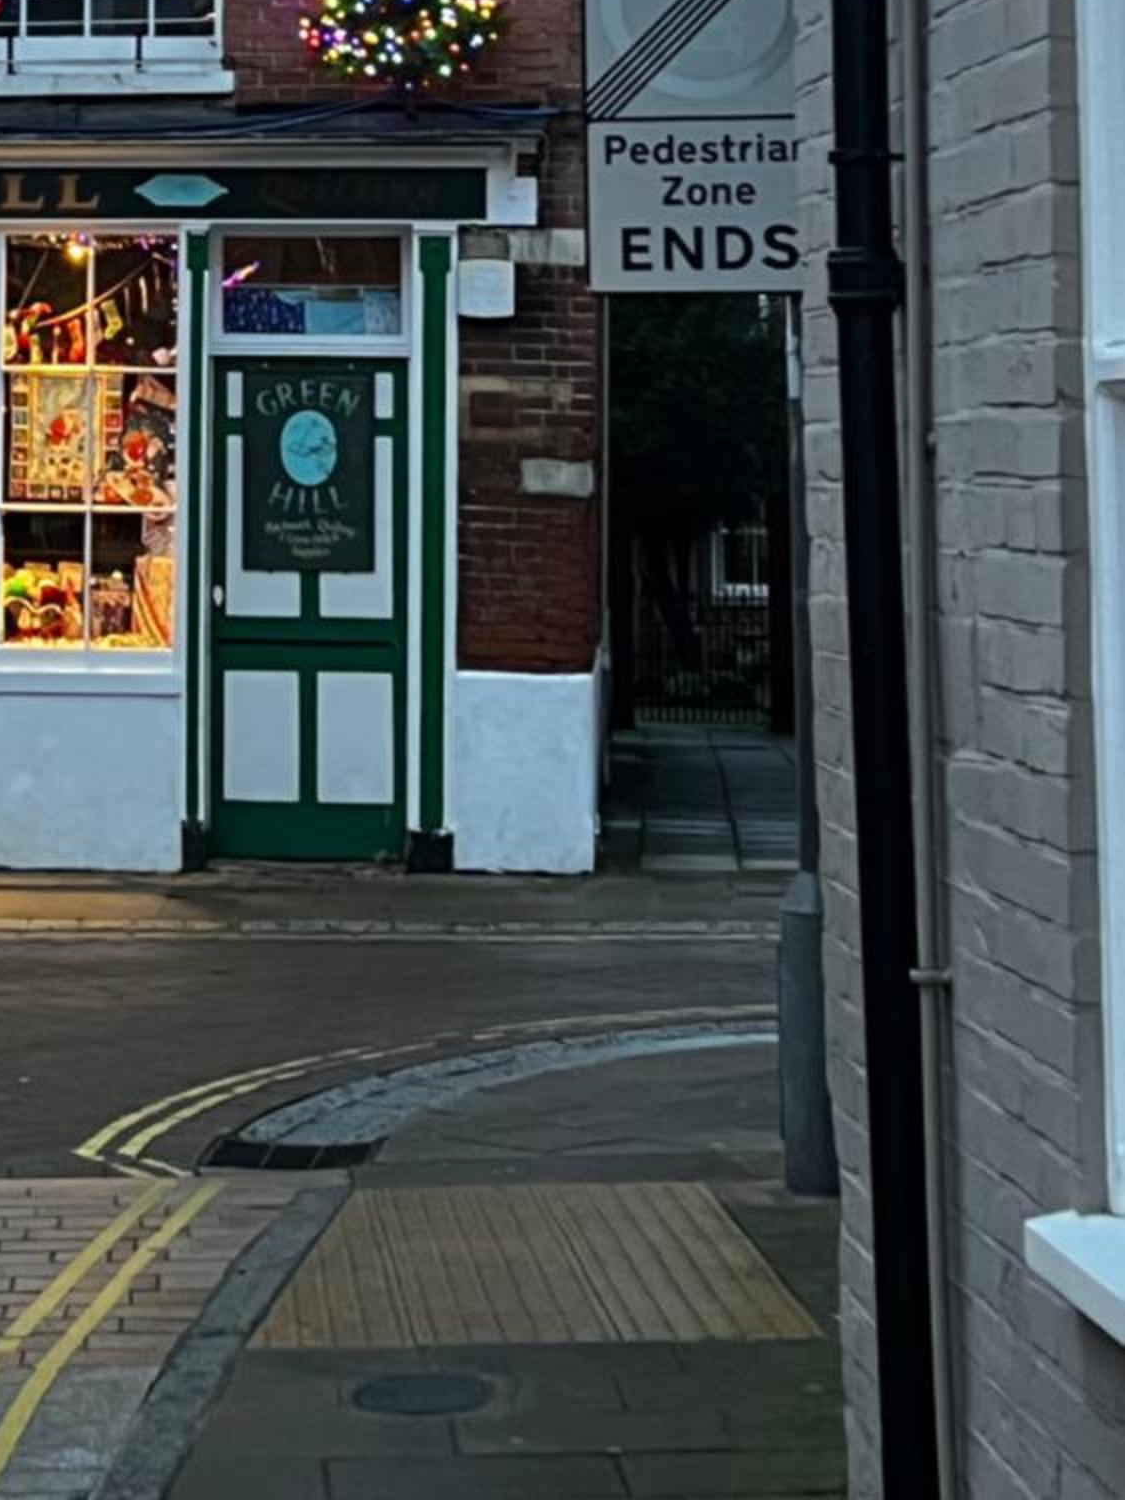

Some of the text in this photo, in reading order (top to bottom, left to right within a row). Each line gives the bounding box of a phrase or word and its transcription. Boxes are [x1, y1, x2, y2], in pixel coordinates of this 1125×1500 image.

[661, 177, 757, 206] Zone
[621, 225, 800, 271] ENDS
[256, 380, 360, 418] GREEN
[268, 480, 348, 514] HILL
